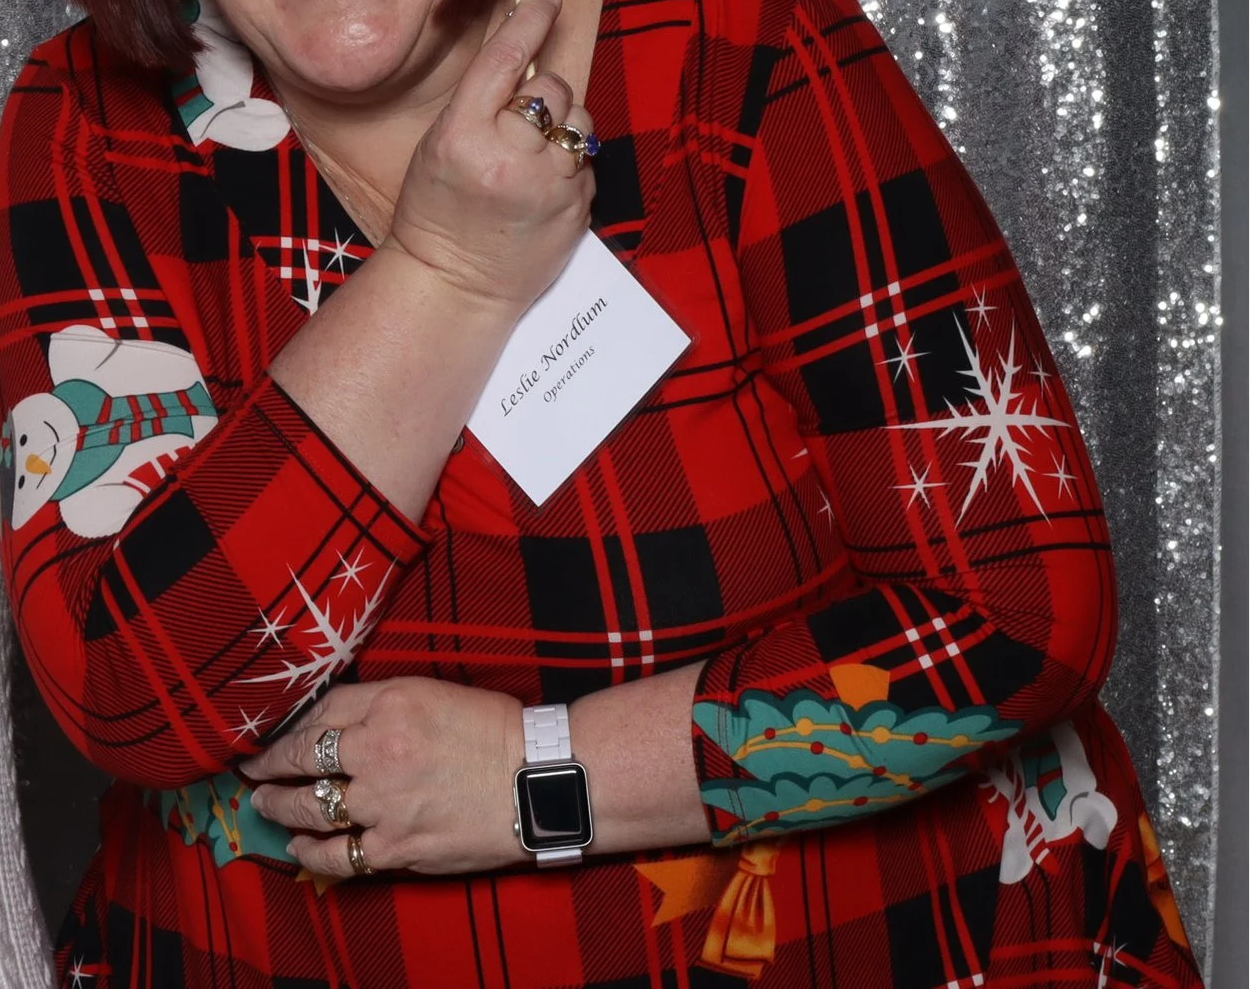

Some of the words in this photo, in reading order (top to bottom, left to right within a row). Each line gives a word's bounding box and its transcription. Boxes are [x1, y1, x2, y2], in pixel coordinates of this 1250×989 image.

[500, 369, 541, 417] Leslie
[540, 297, 608, 372] Nordlum
[543, 345, 596, 403] Operations
